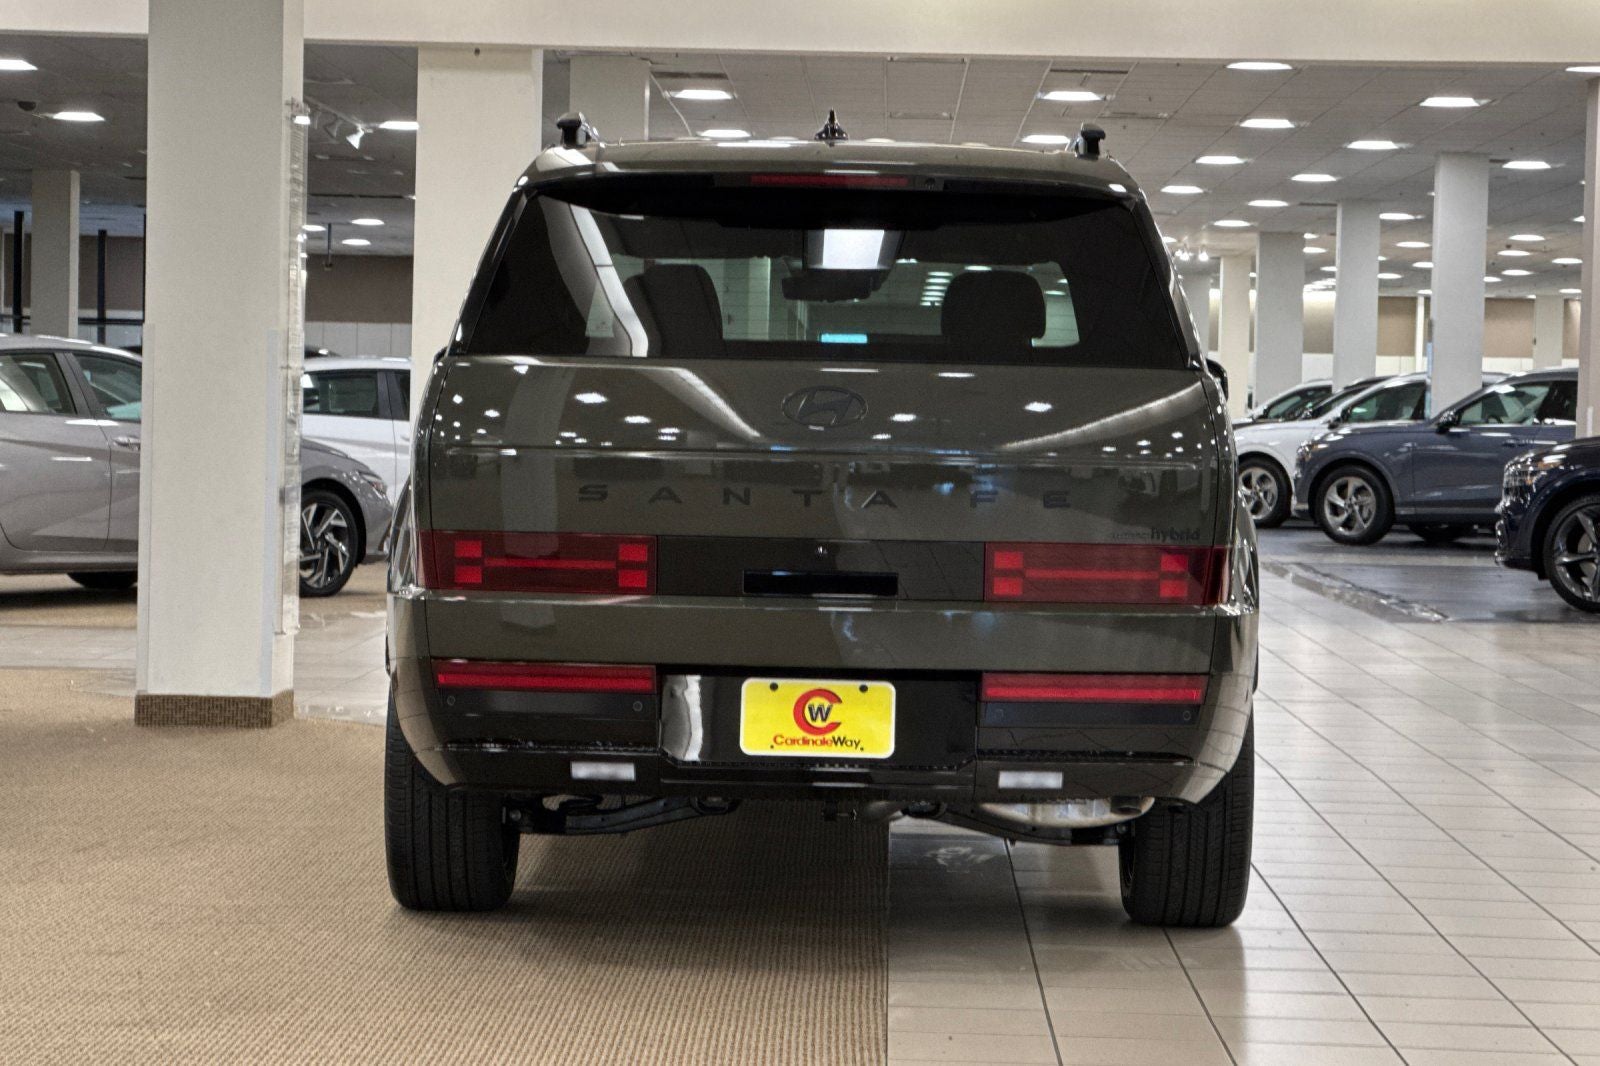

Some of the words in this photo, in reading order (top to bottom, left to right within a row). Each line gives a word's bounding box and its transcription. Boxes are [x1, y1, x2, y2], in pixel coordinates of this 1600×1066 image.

[578, 484, 899, 509] SANTA
[969, 488, 1071, 510] FE
[1151, 526, 1200, 542] hybrid
[773, 734, 861, 749] CardinaleWay
